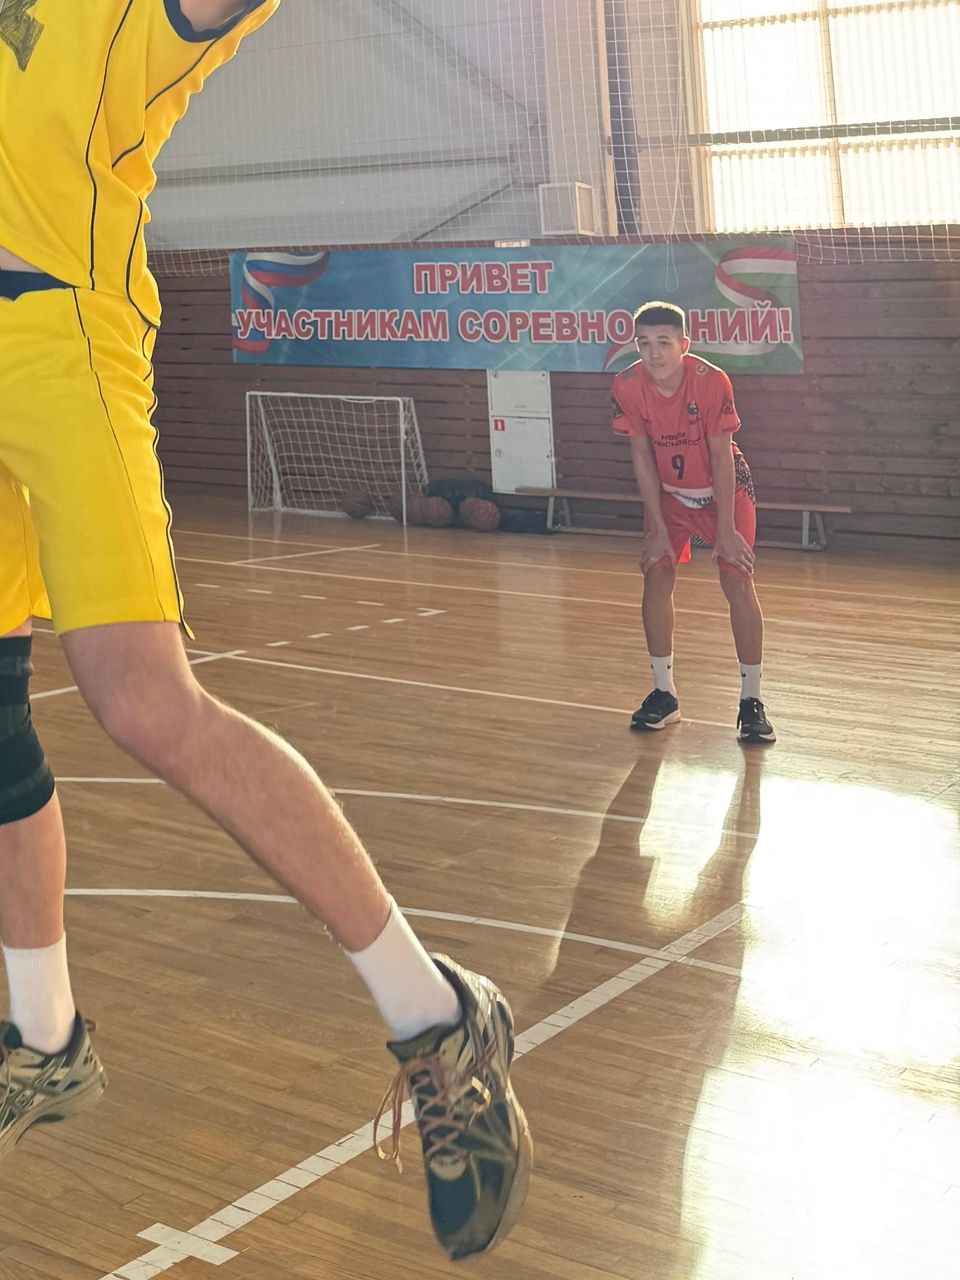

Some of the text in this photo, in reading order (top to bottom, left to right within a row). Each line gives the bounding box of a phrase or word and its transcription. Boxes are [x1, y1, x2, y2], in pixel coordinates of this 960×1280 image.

[413, 261, 554, 295] ПРИВЕТ
[236, 300, 794, 344] УЧАСТНИКАМ СОРЕВНОНИЙ!
[671, 454, 685, 480] 9
